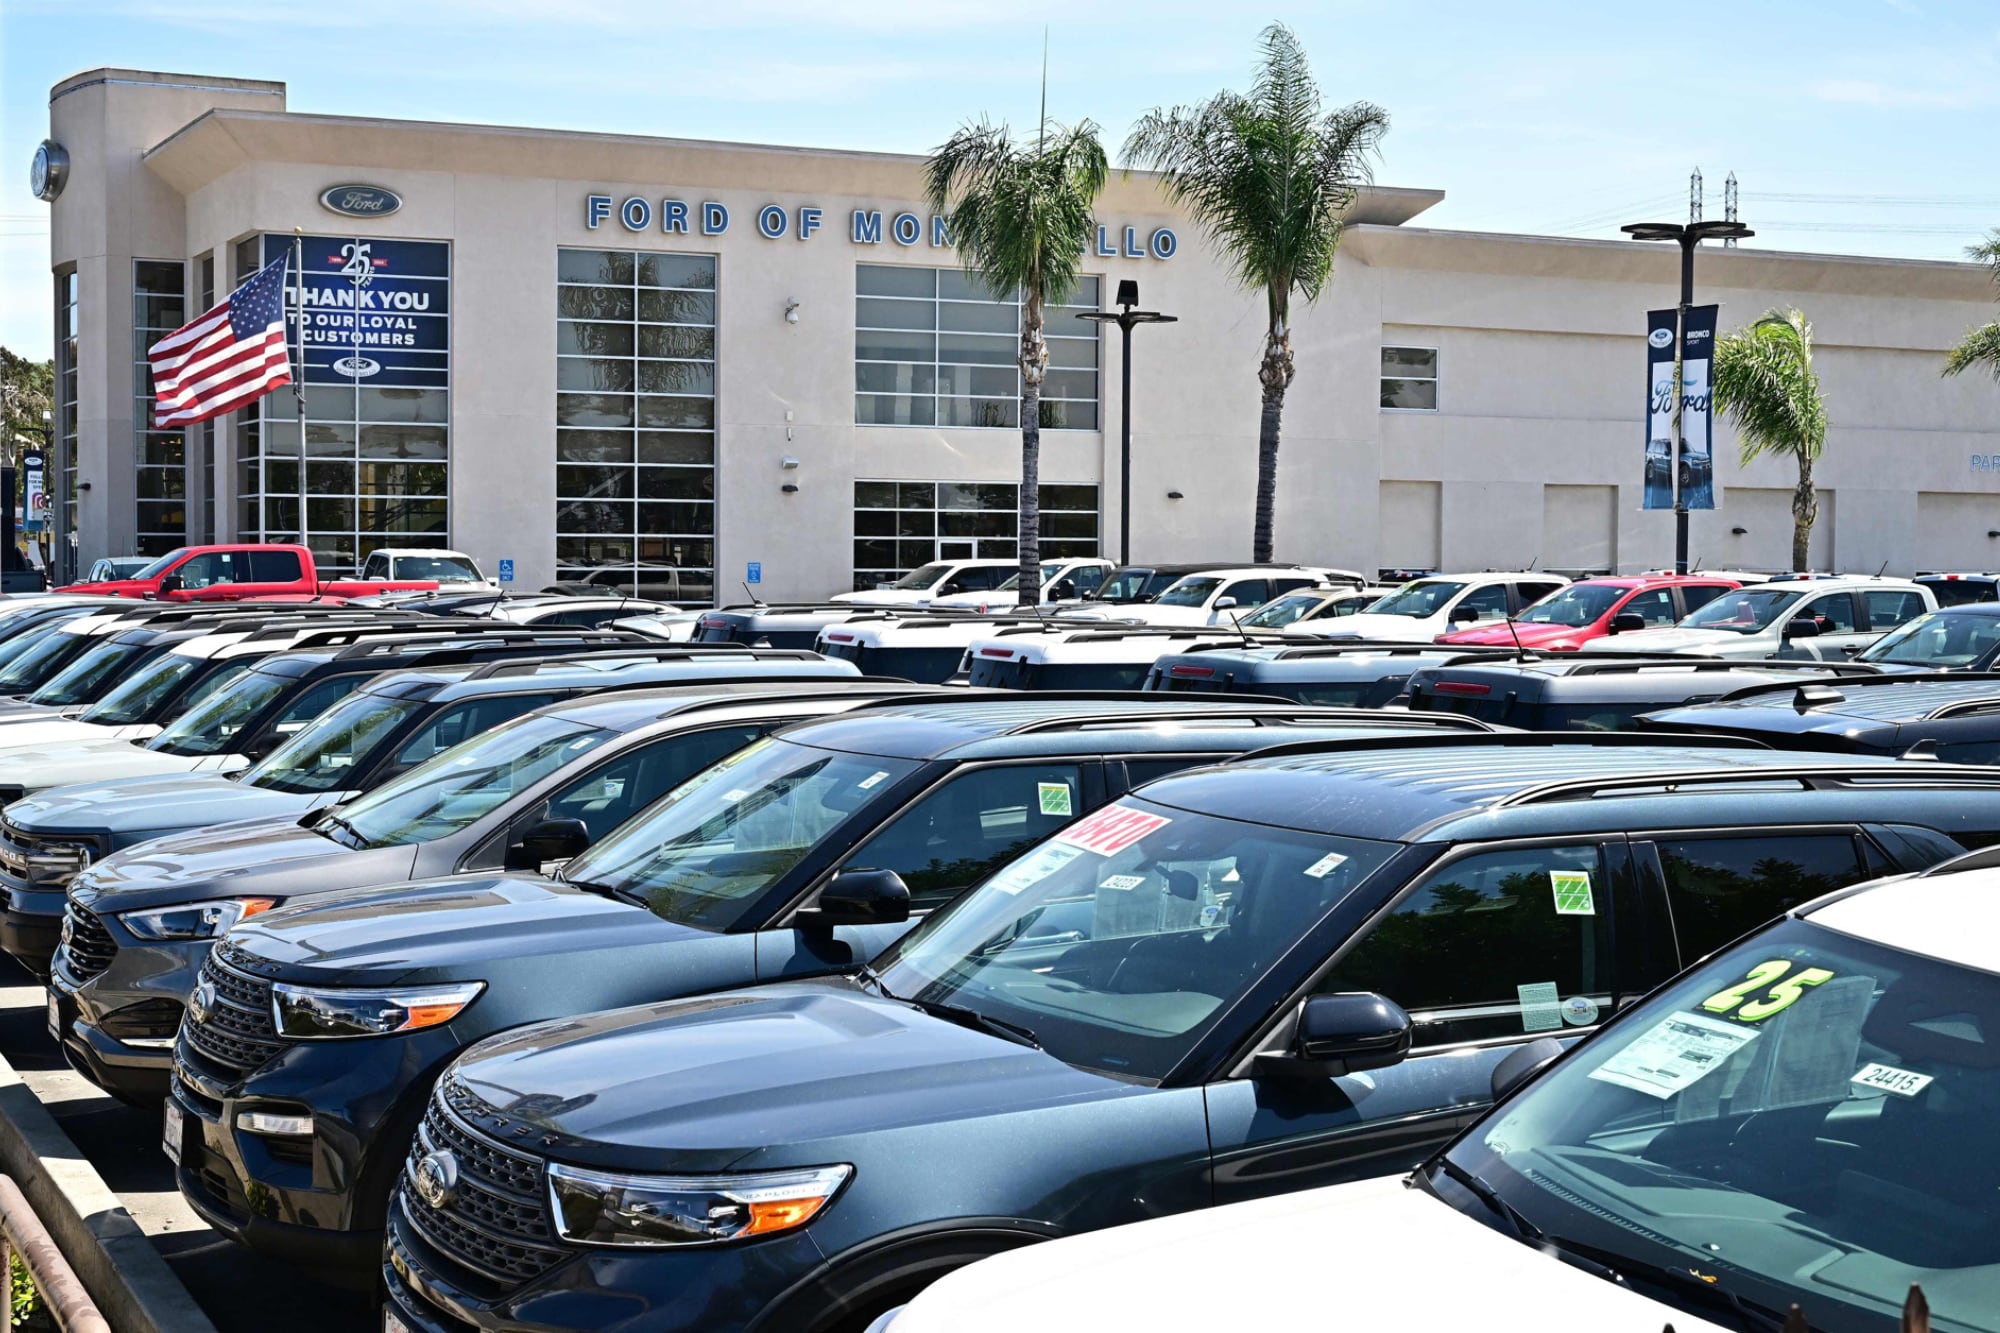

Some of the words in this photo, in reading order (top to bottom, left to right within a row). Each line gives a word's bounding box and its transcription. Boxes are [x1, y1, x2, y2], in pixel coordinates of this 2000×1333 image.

[341, 191, 384, 210] Ford
[586, 195, 730, 236] FORD
[758, 204, 824, 241] OF
[852, 209, 1178, 260] MONLLO
[340, 243, 371, 285] 25
[285, 287, 376, 308] THANK
[378, 290, 430, 311] YOU
[287, 312, 311, 326] TO
[316, 313, 354, 327] OUR
[360, 316, 417, 330] LOYAL
[302, 330, 415, 346] CUSTOMERS
[1702, 960, 1835, 1022] 25
